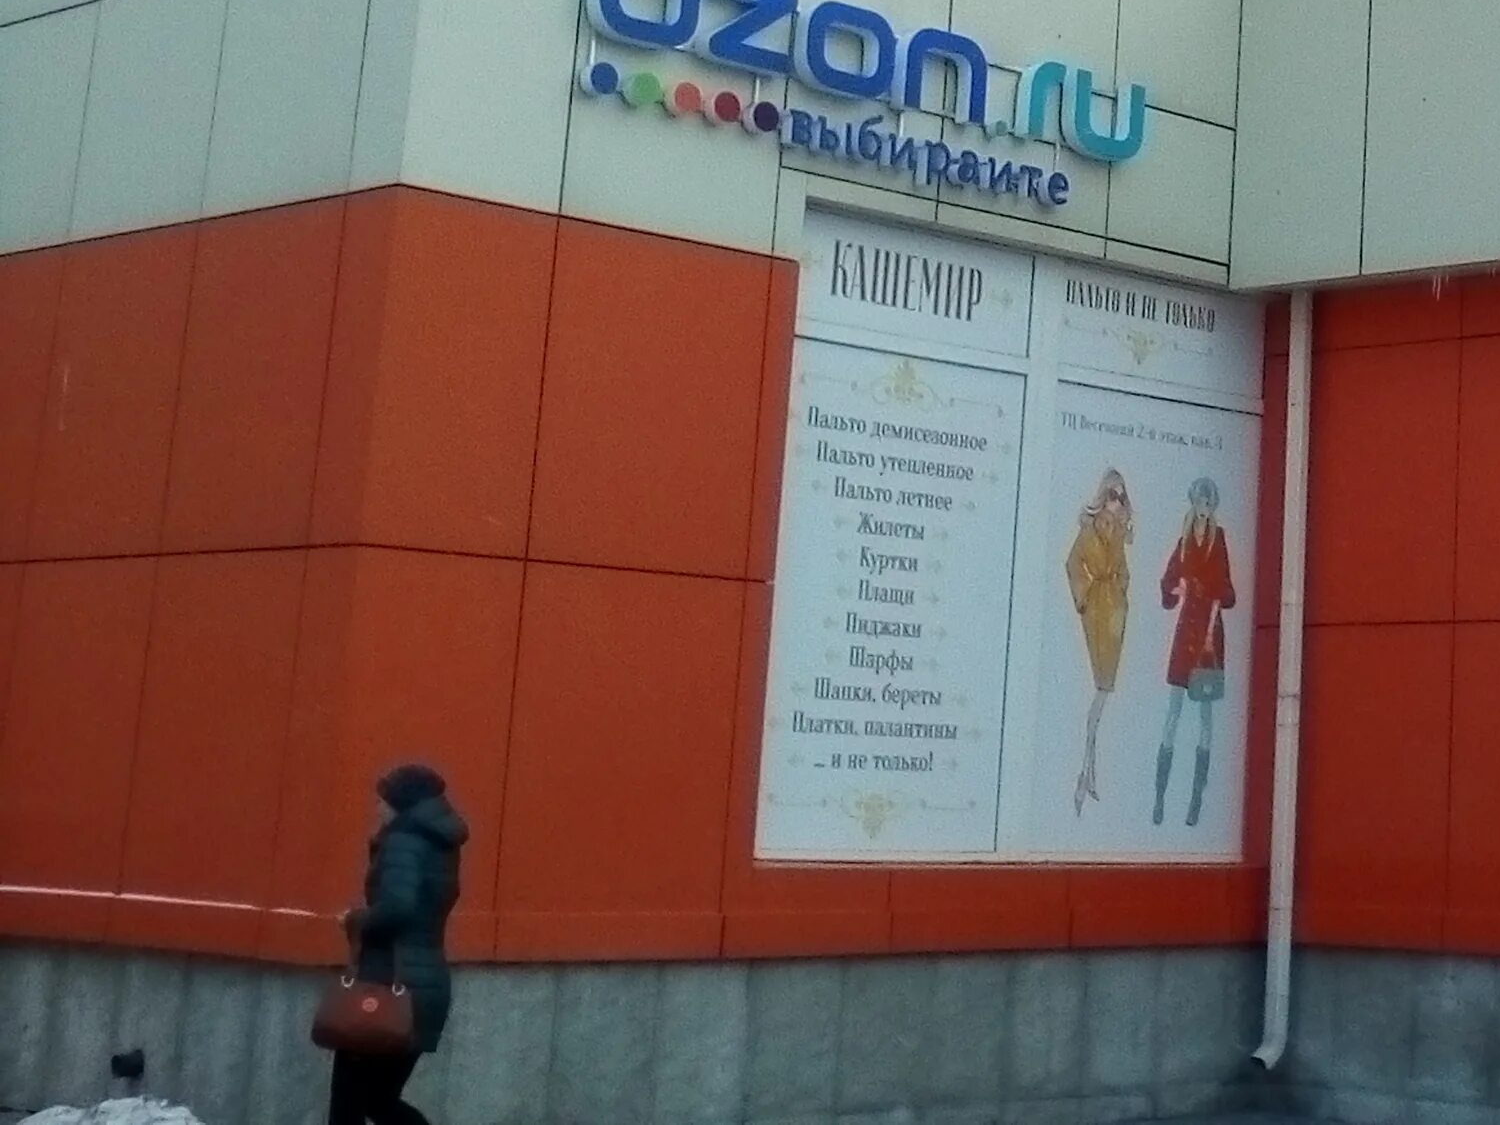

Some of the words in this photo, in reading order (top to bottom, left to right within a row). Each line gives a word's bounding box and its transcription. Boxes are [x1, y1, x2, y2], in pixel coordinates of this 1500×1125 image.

[830, 239, 984, 322] КАШЕМИР
[1165, 300, 1215, 333] ТОЛЬКО
[808, 406, 866, 433] Пальто
[870, 421, 987, 452] демисезонное
[817, 440, 875, 468] Пальто
[879, 454, 974, 482] утепленное
[834, 476, 892, 503] Пальто
[896, 489, 953, 511] летнее
[856, 511, 925, 540] Жилеты
[860, 546, 918, 575] Куртки
[858, 580, 914, 606] Плащи
[846, 612, 921, 639] Пиджаки
[849, 645, 913, 675] Шарфы
[814, 677, 876, 703] Шапки,
[881, 683, 942, 710] береты
[793, 710, 858, 736] Платки,
[864, 721, 957, 740] палантины
[848, 755, 868, 770] не
[873, 751, 933, 772] только!
